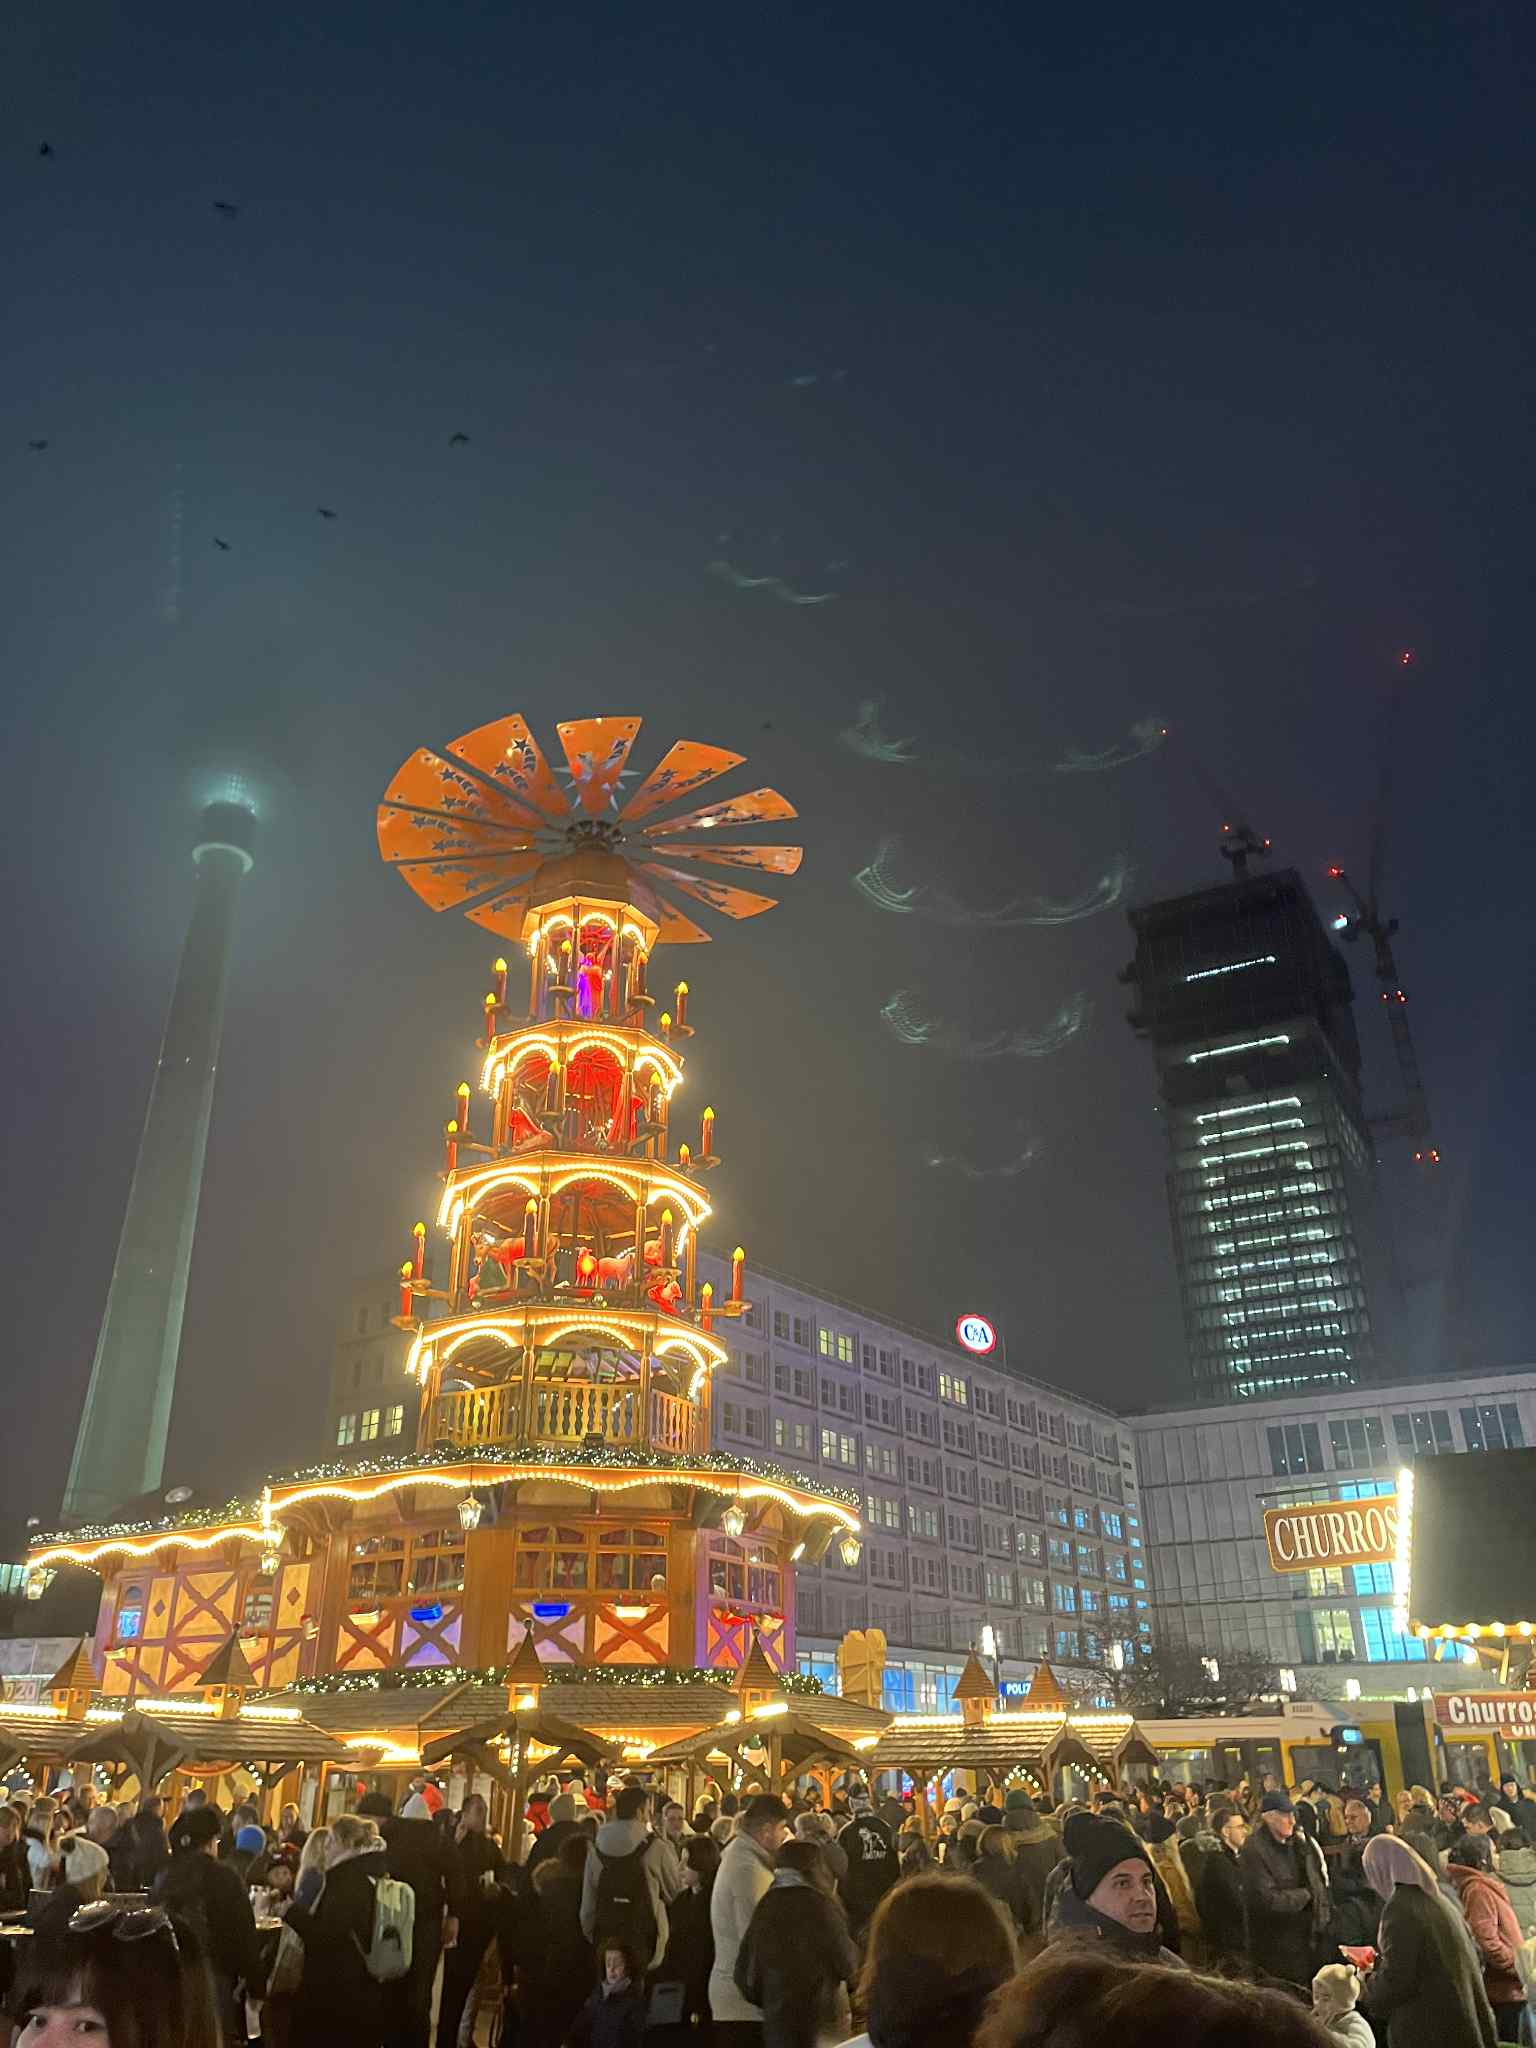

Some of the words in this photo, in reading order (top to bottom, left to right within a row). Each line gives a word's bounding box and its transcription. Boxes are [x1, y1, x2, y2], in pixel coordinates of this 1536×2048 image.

[964, 1324, 989, 1343] C&A
[1274, 1505, 1400, 1561] CHURROS
[1448, 1696, 1536, 1723] Churro
